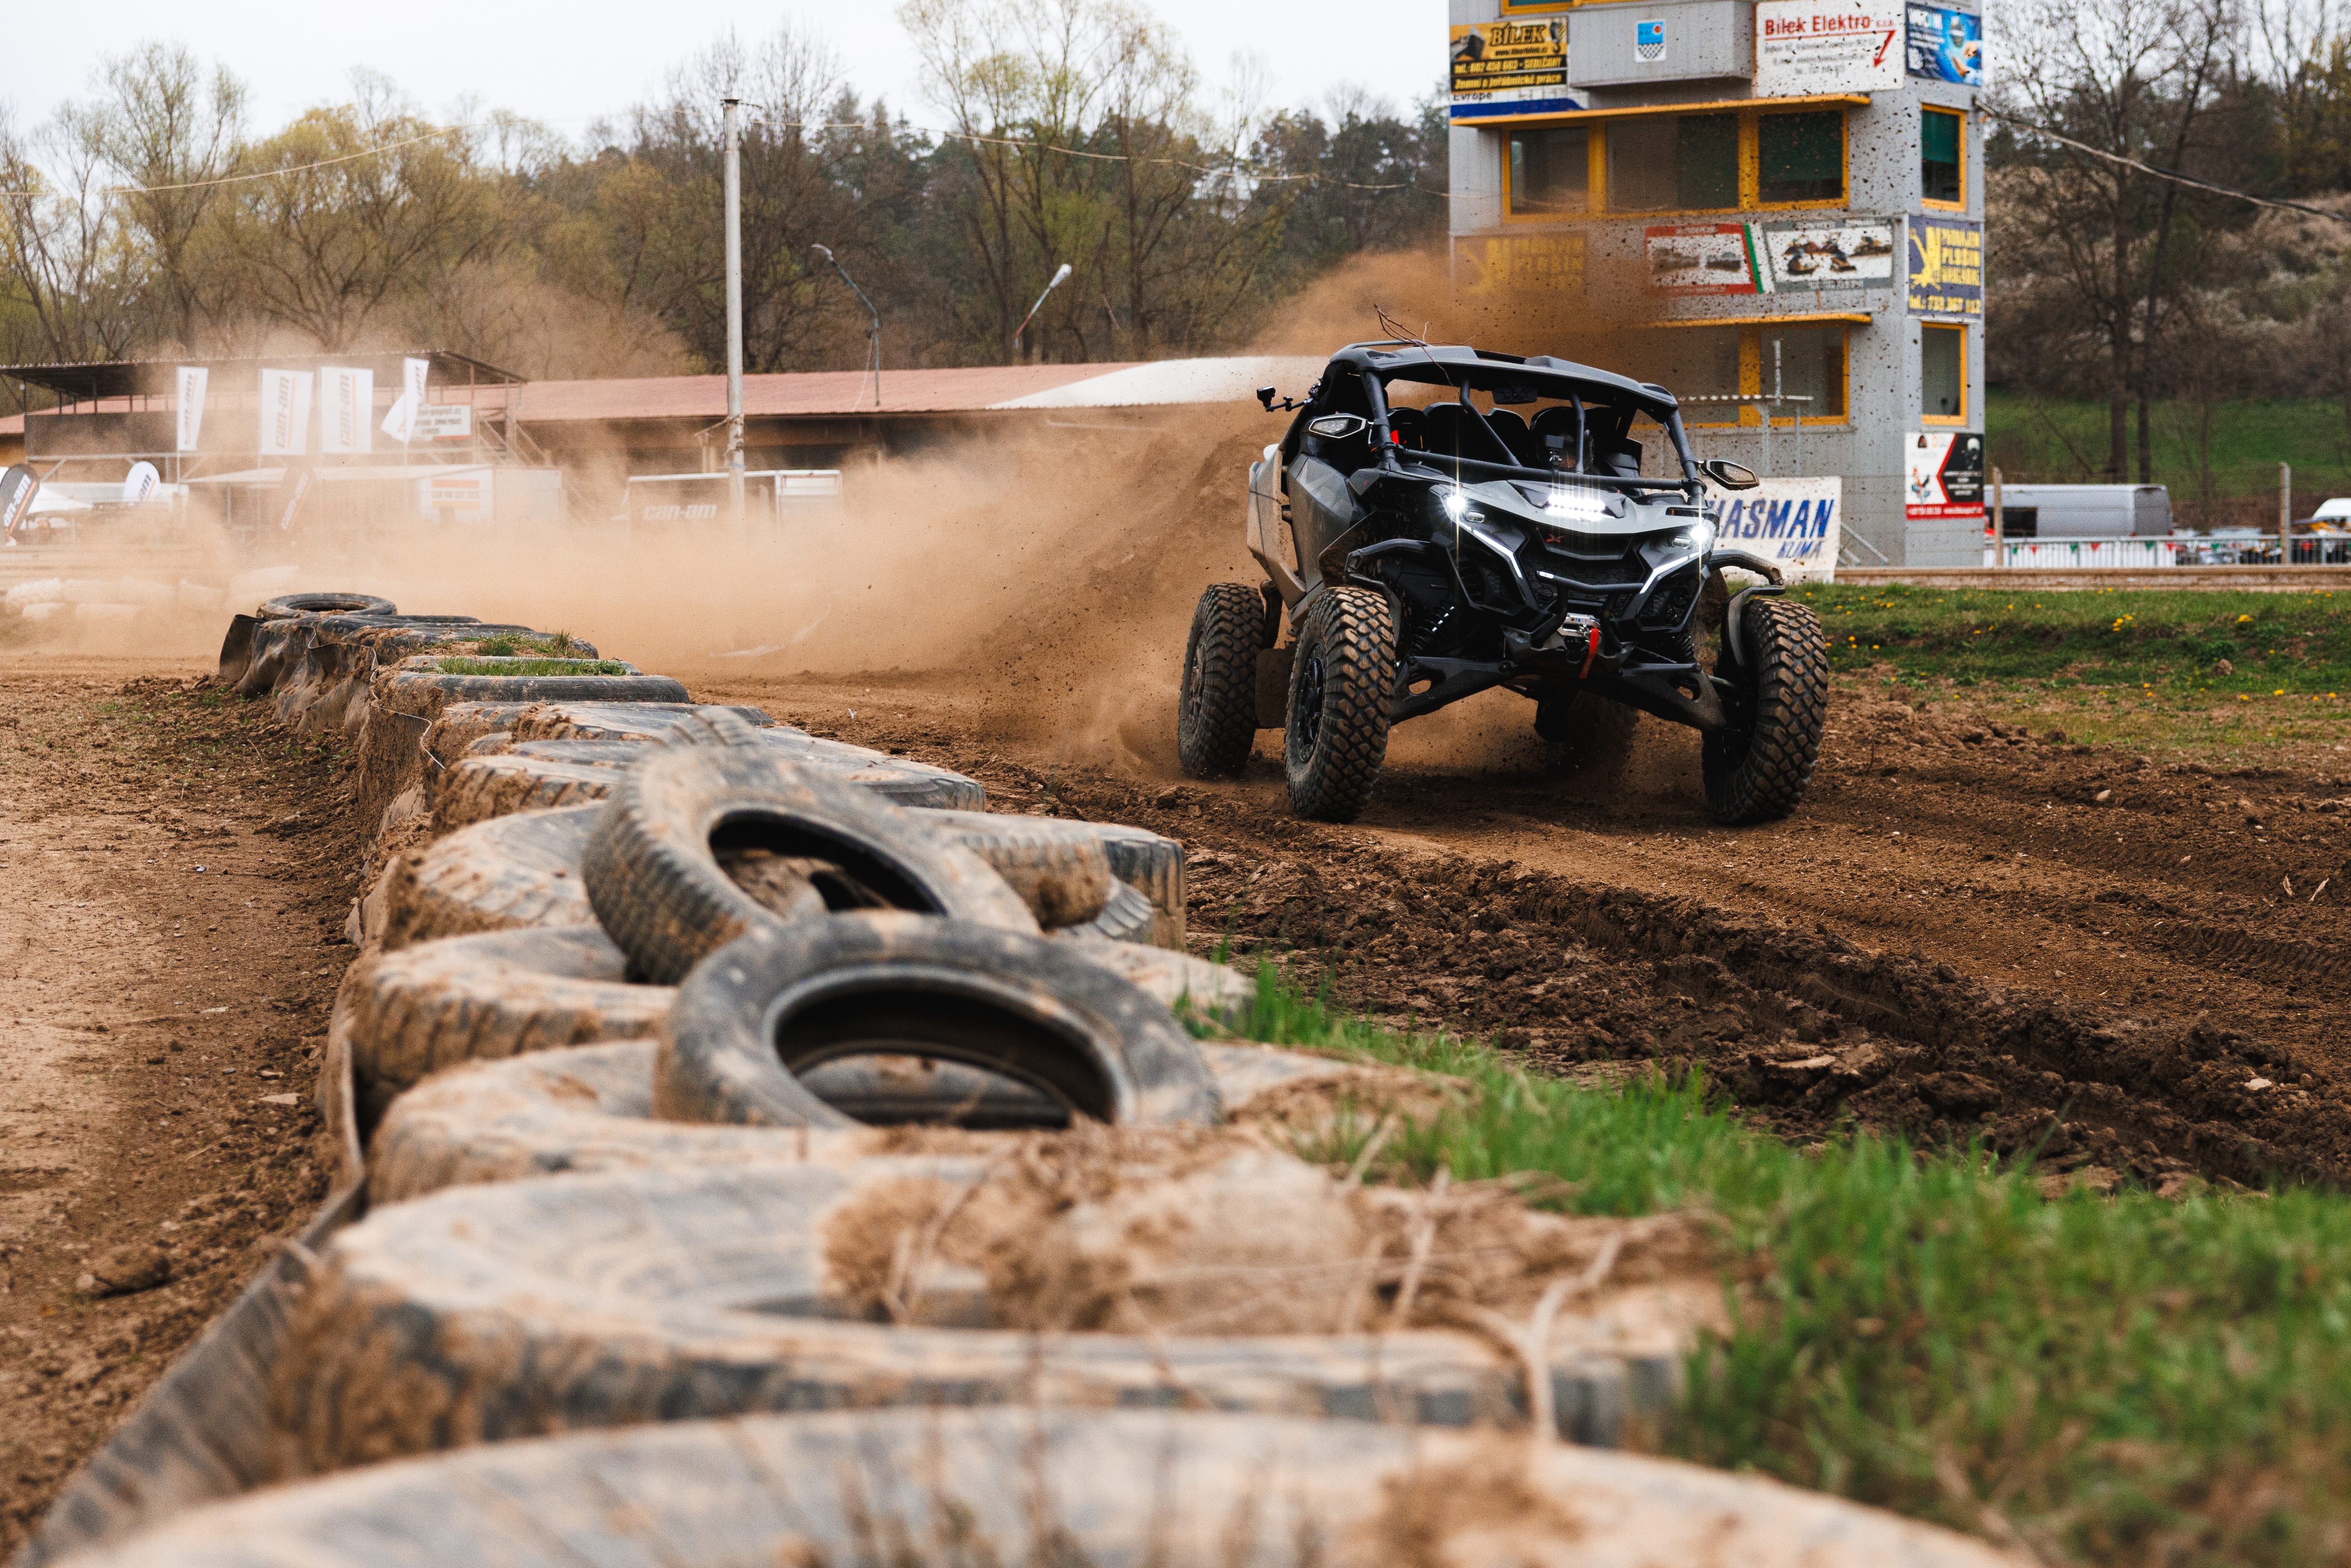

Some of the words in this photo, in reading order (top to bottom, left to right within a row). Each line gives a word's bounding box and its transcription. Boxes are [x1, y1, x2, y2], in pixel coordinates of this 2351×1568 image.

[1490, 22, 1546, 47] BÍLEK
[1813, 14, 1870, 32] Elektro
[276, 376, 290, 449] can-am
[339, 374, 351, 448] can-am
[3, 474, 31, 527] an-am
[643, 504, 718, 520] can-am
